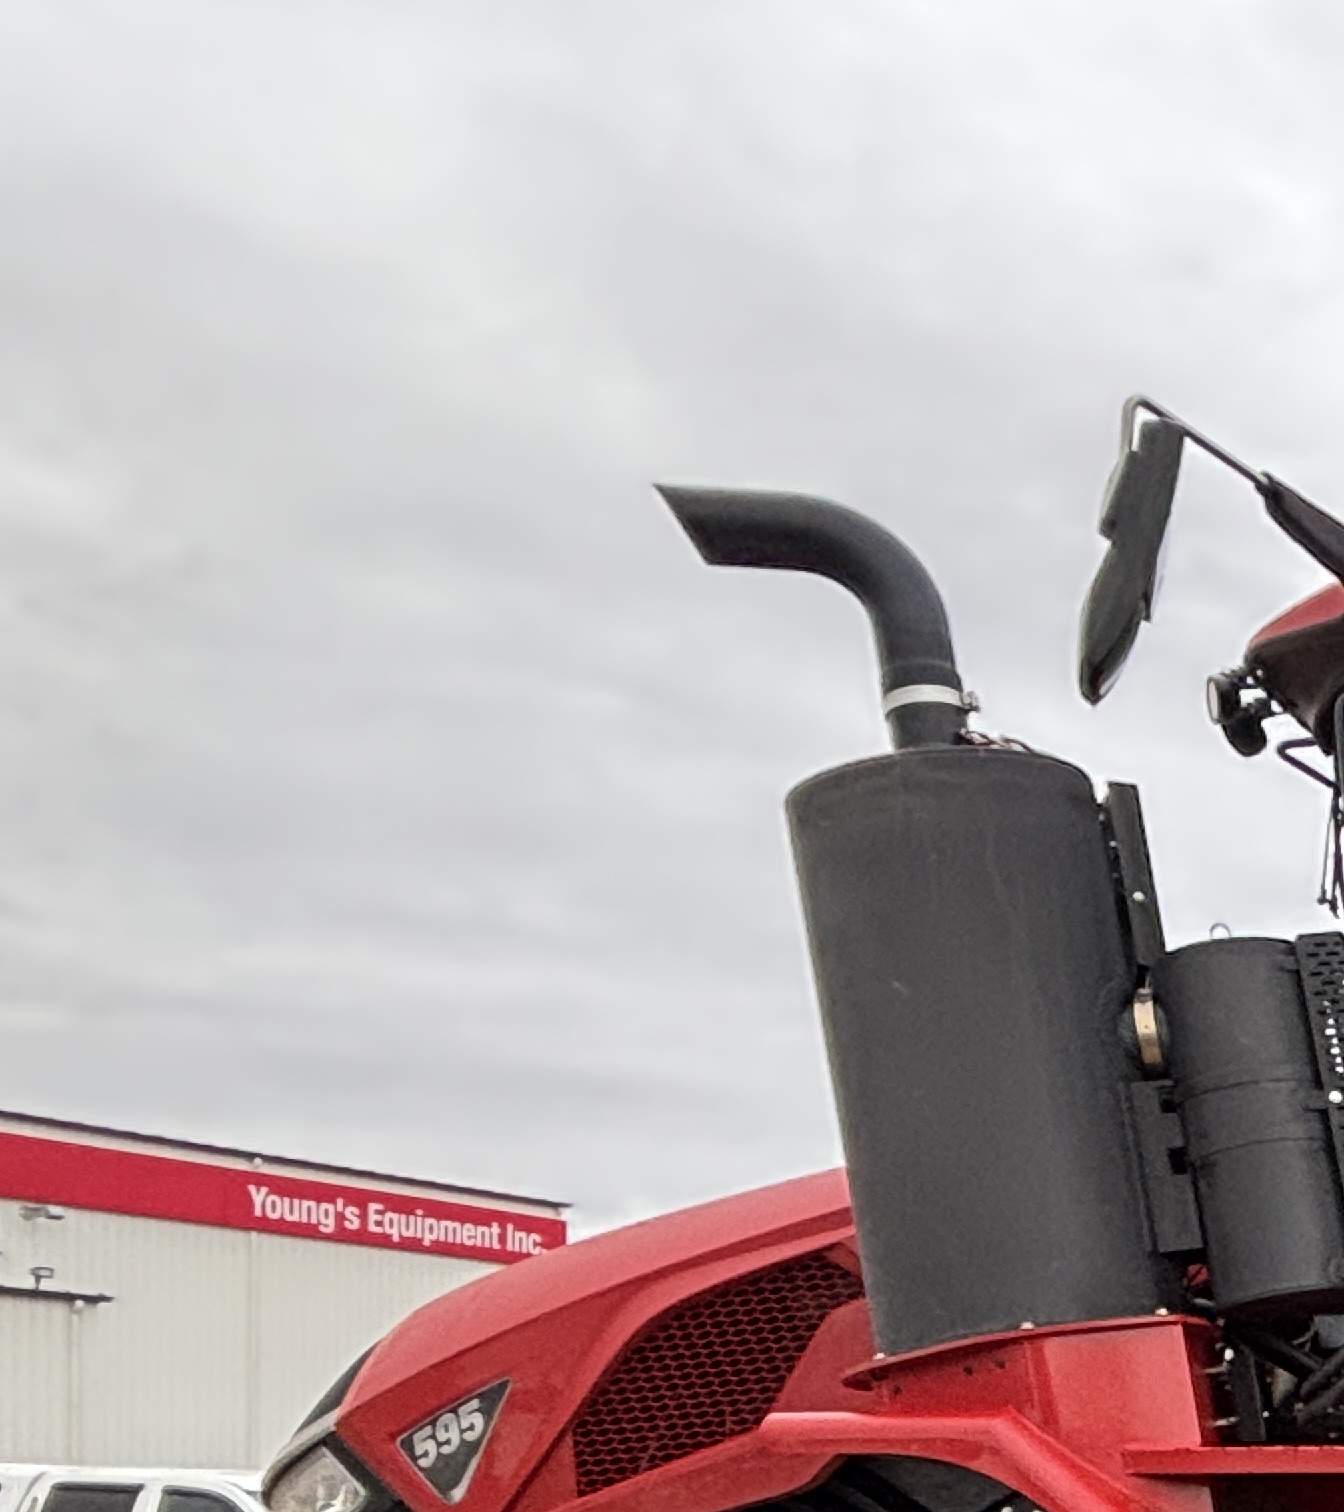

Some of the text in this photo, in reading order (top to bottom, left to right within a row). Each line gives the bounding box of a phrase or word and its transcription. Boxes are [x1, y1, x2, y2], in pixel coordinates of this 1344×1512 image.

[247, 1184, 360, 1233] Young's
[367, 1202, 502, 1249] Equipment
[412, 1398, 484, 1468] 595
